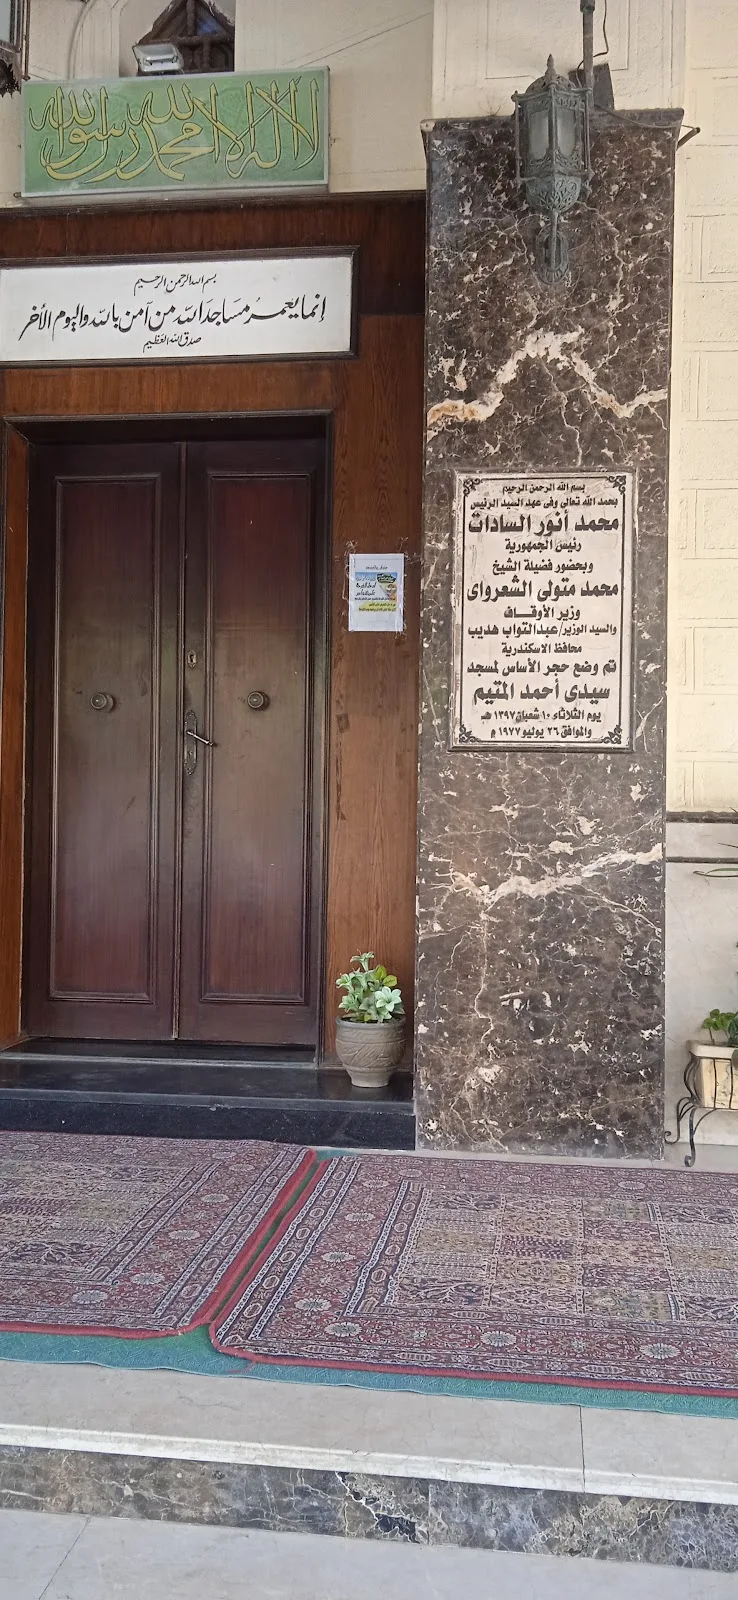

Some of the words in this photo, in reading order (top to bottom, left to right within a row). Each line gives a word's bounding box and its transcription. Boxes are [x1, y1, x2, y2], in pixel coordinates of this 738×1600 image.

[29, 86, 96, 158] الله
[40, 86, 140, 184] رسول
[117, 118, 216, 181] محمد
[133, 275, 166, 296] الرحيم
[166, 274, 191, 293] الرحمن
[189, 275, 204, 286] الله
[202, 273, 217, 293] بسم
[88, 303, 120, 328] بالله
[173, 300, 203, 325] الله
[301, 294, 327, 323] إنما
[52, 303, 89, 341] واليوم
[118, 301, 153, 333] آمن
[148, 304, 176, 331] من
[169, 334, 183, 343] الله
[178, 331, 202, 347] صدق
[502, 483, 527, 495] الرحيم
[529, 482, 555, 493] الرحمن
[556, 481, 569, 491] الله
[570, 483, 586, 493] بسم
[470, 497, 499, 510] الرئيس
[500, 498, 523, 510] السيد
[526, 498, 542, 508] عهد
[543, 496, 559, 509] وفى
[560, 496, 580, 509] تعالى
[582, 495, 596, 506] الله
[598, 498, 618, 508] بحمد
[468, 513, 531, 533] السادات
[533, 509, 569, 537] أنور
[575, 515, 619, 533] محمد
[504, 538, 553, 554] الجمهورية
[555, 537, 582, 553] رئيس
[492, 557, 521, 576] الشيخ
[524, 558, 553, 574] فضيلة
[554, 558, 594, 574] وبحضور
[537, 577, 576, 602] متولى
[581, 580, 619, 597] محمد
[556, 604, 581, 622] وزير
[468, 624, 499, 639] هديب
[589, 624, 618, 636] والسيد
[501, 641, 551, 657] الاسكندرية
[554, 642, 582, 655] محافظ
[466, 659, 499, 677] لمسجد
[502, 657, 541, 677] الأساس
[543, 662, 570, 677] حجر
[572, 660, 599, 678] وضع
[603, 659, 617, 676] تم
[473, 680, 515, 706] المتيم
[520, 678, 560, 700] أحمد
[564, 683, 611, 705] سيدى
[494, 710, 516, 720] ١٣٩٧
[515, 707, 540, 723] شعبان
[553, 707, 585, 721] الثلاثاء
[586, 710, 602, 722] يوم
[490, 728, 497, 738] م
[498, 726, 521, 736] ١٩٧٧
[521, 726, 544, 739] يوليو
[547, 726, 560, 736] ٢٦
[560, 725, 592, 739] والموافق
